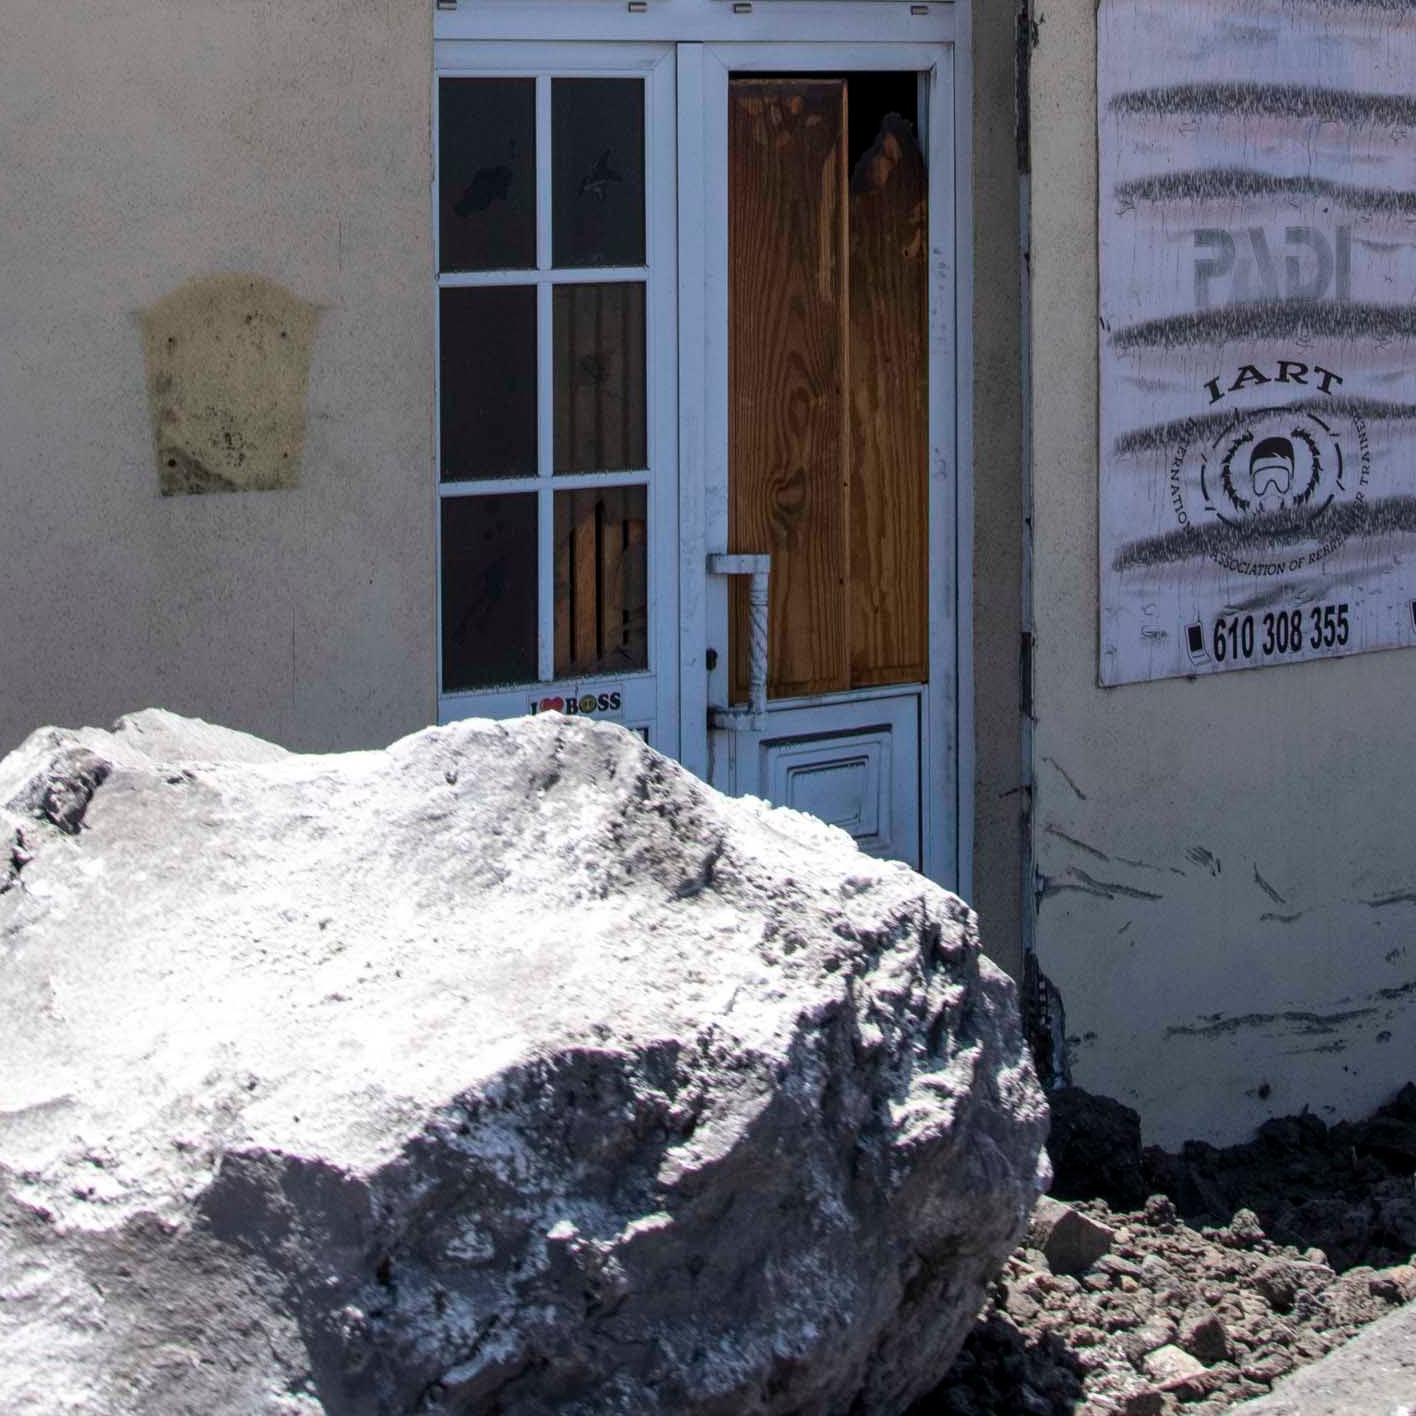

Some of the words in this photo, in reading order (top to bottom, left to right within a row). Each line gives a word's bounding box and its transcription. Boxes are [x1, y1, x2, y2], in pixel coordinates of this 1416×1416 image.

[1193, 225, 1352, 313] PADI
[1203, 360, 1344, 405] IART
[1288, 557, 1306, 572] OF
[1212, 615, 1255, 663] 610
[1261, 608, 1303, 656] 308
[1309, 603, 1350, 650] 355
